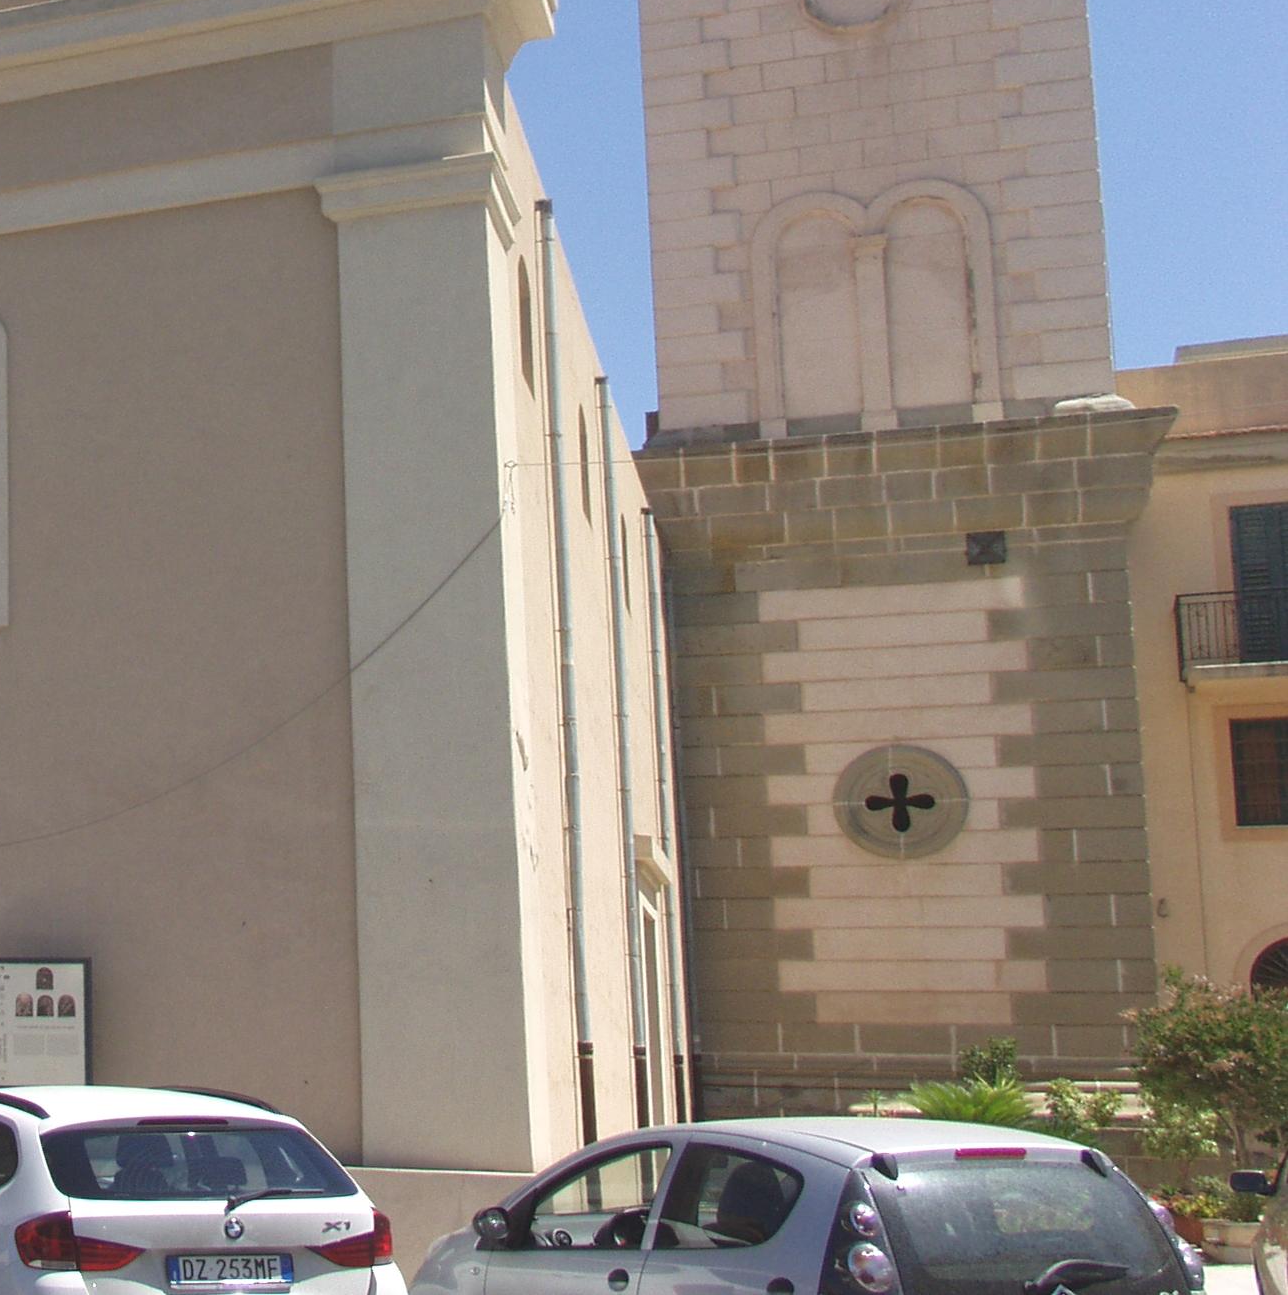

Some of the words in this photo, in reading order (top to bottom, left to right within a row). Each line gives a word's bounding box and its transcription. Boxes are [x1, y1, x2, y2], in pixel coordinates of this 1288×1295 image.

[321, 1220, 351, 1233] X1
[182, 1259, 208, 1281] DZ
[217, 1258, 278, 1281] 253MF
